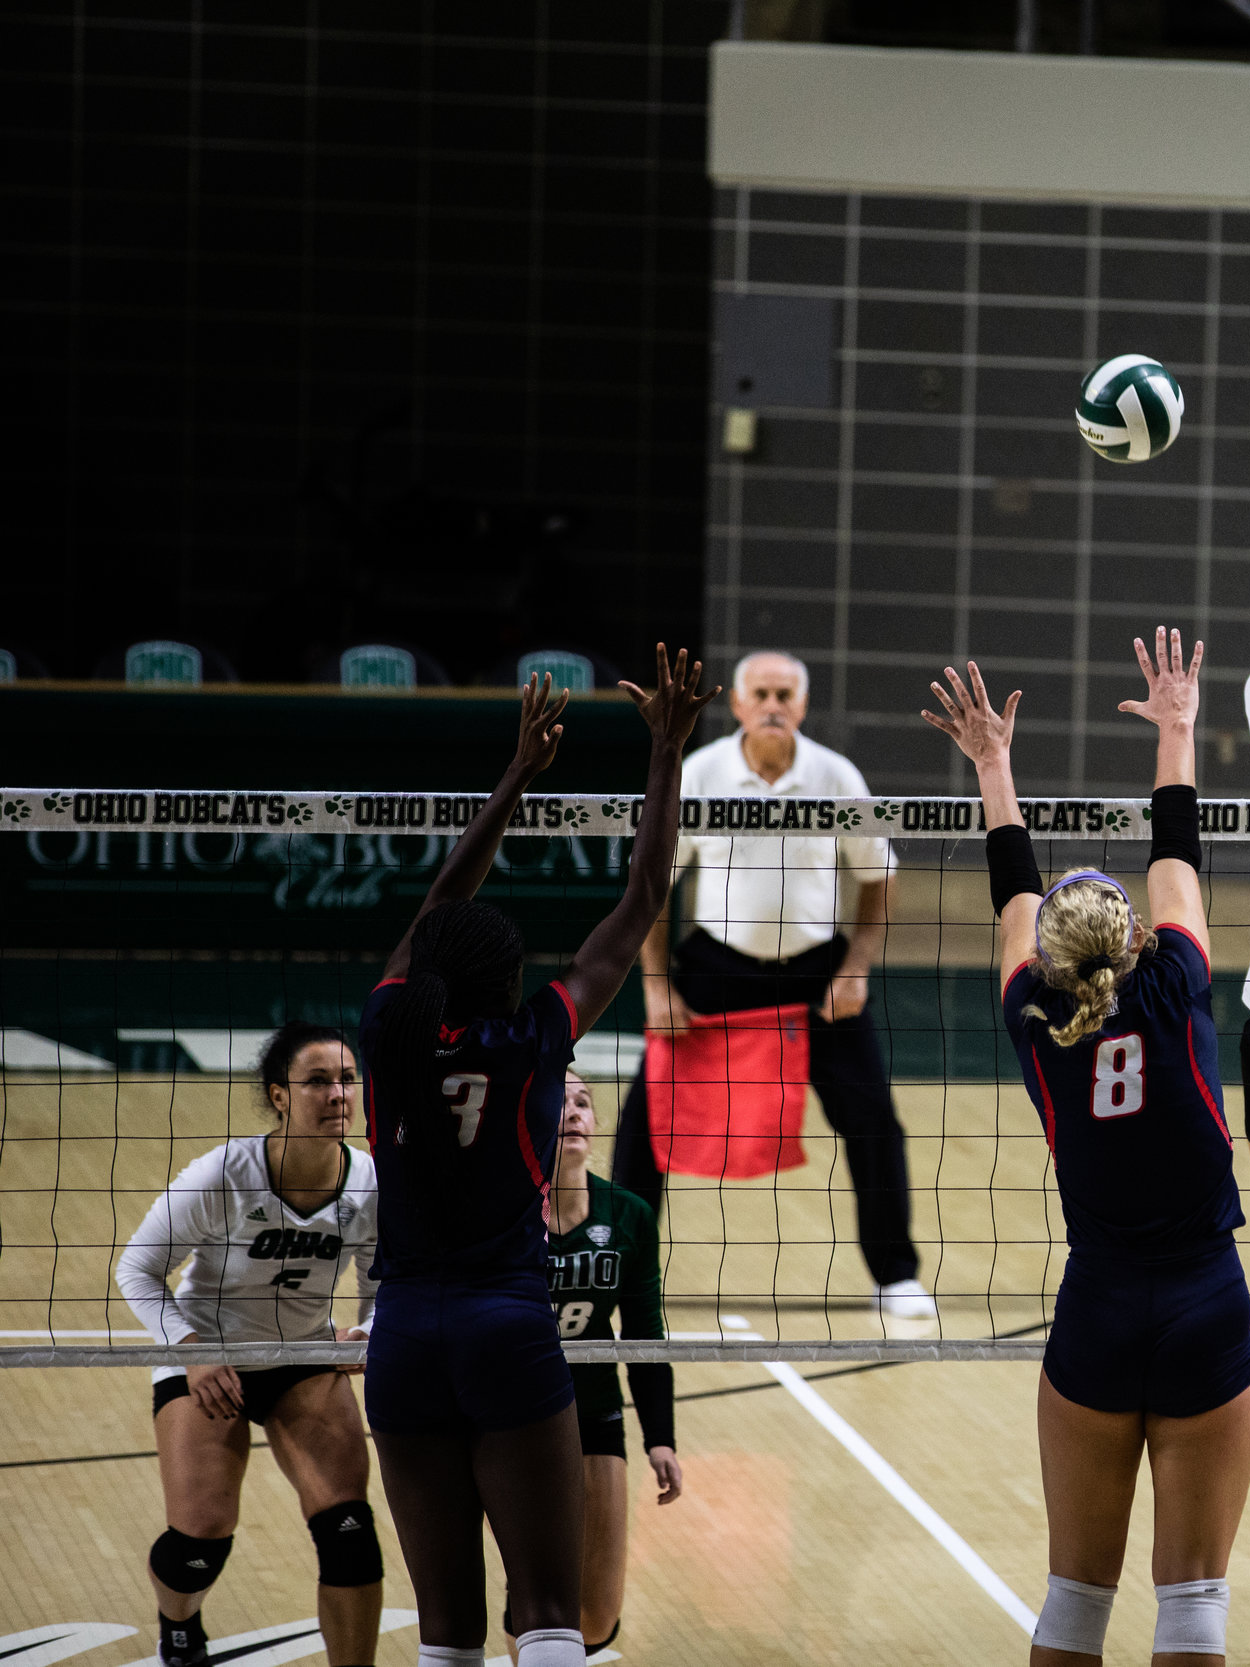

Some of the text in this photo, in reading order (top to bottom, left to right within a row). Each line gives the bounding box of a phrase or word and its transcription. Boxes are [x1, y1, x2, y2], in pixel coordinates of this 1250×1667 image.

[73, 793, 286, 825] OHIO BOBCATS
[356, 796, 562, 828] OHIO BOATS
[708, 800, 835, 829] BOBCATS
[903, 801, 972, 831] OHIO
[1089, 1030, 1147, 1122] 8
[440, 1072, 490, 1150] 3
[248, 1228, 343, 1260] OHIO
[548, 1249, 622, 1292] HIO
